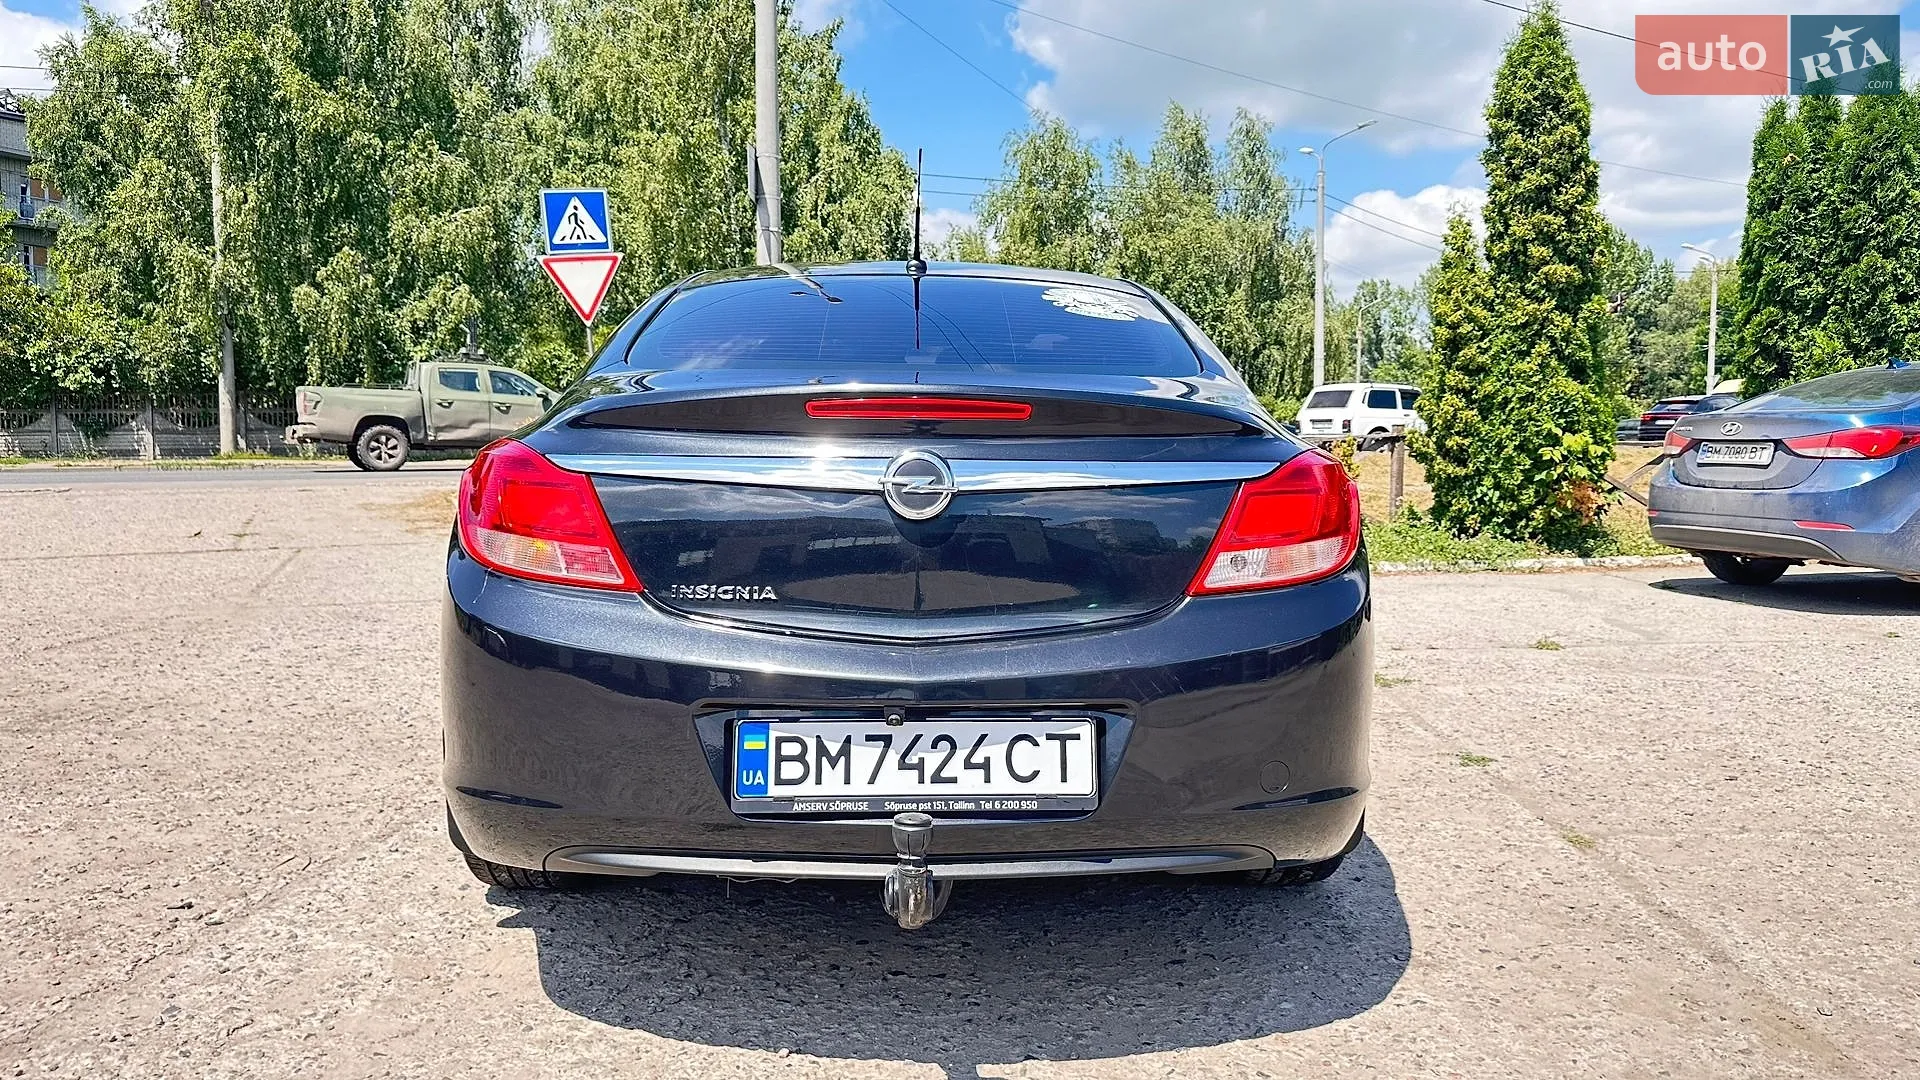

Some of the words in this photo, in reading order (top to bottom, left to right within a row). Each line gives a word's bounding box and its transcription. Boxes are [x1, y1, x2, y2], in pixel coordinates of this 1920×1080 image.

[1706, 445, 1721, 458] BM
[1749, 446, 1767, 460] BT
[671, 584, 778, 600] INSIGNIA
[774, 735, 851, 785] BM
[865, 733, 991, 785] 7424
[1005, 732, 1081, 785] CT
[743, 769, 765, 786] UA
[792, 802, 828, 811] AMSERV
[918, 802, 931, 812] pst
[932, 801, 947, 811] 151,
[948, 801, 975, 810] Tallinn
[980, 801, 992, 810] Tel
[1002, 801, 1019, 810] 200
[1020, 801, 1038, 810] 950
